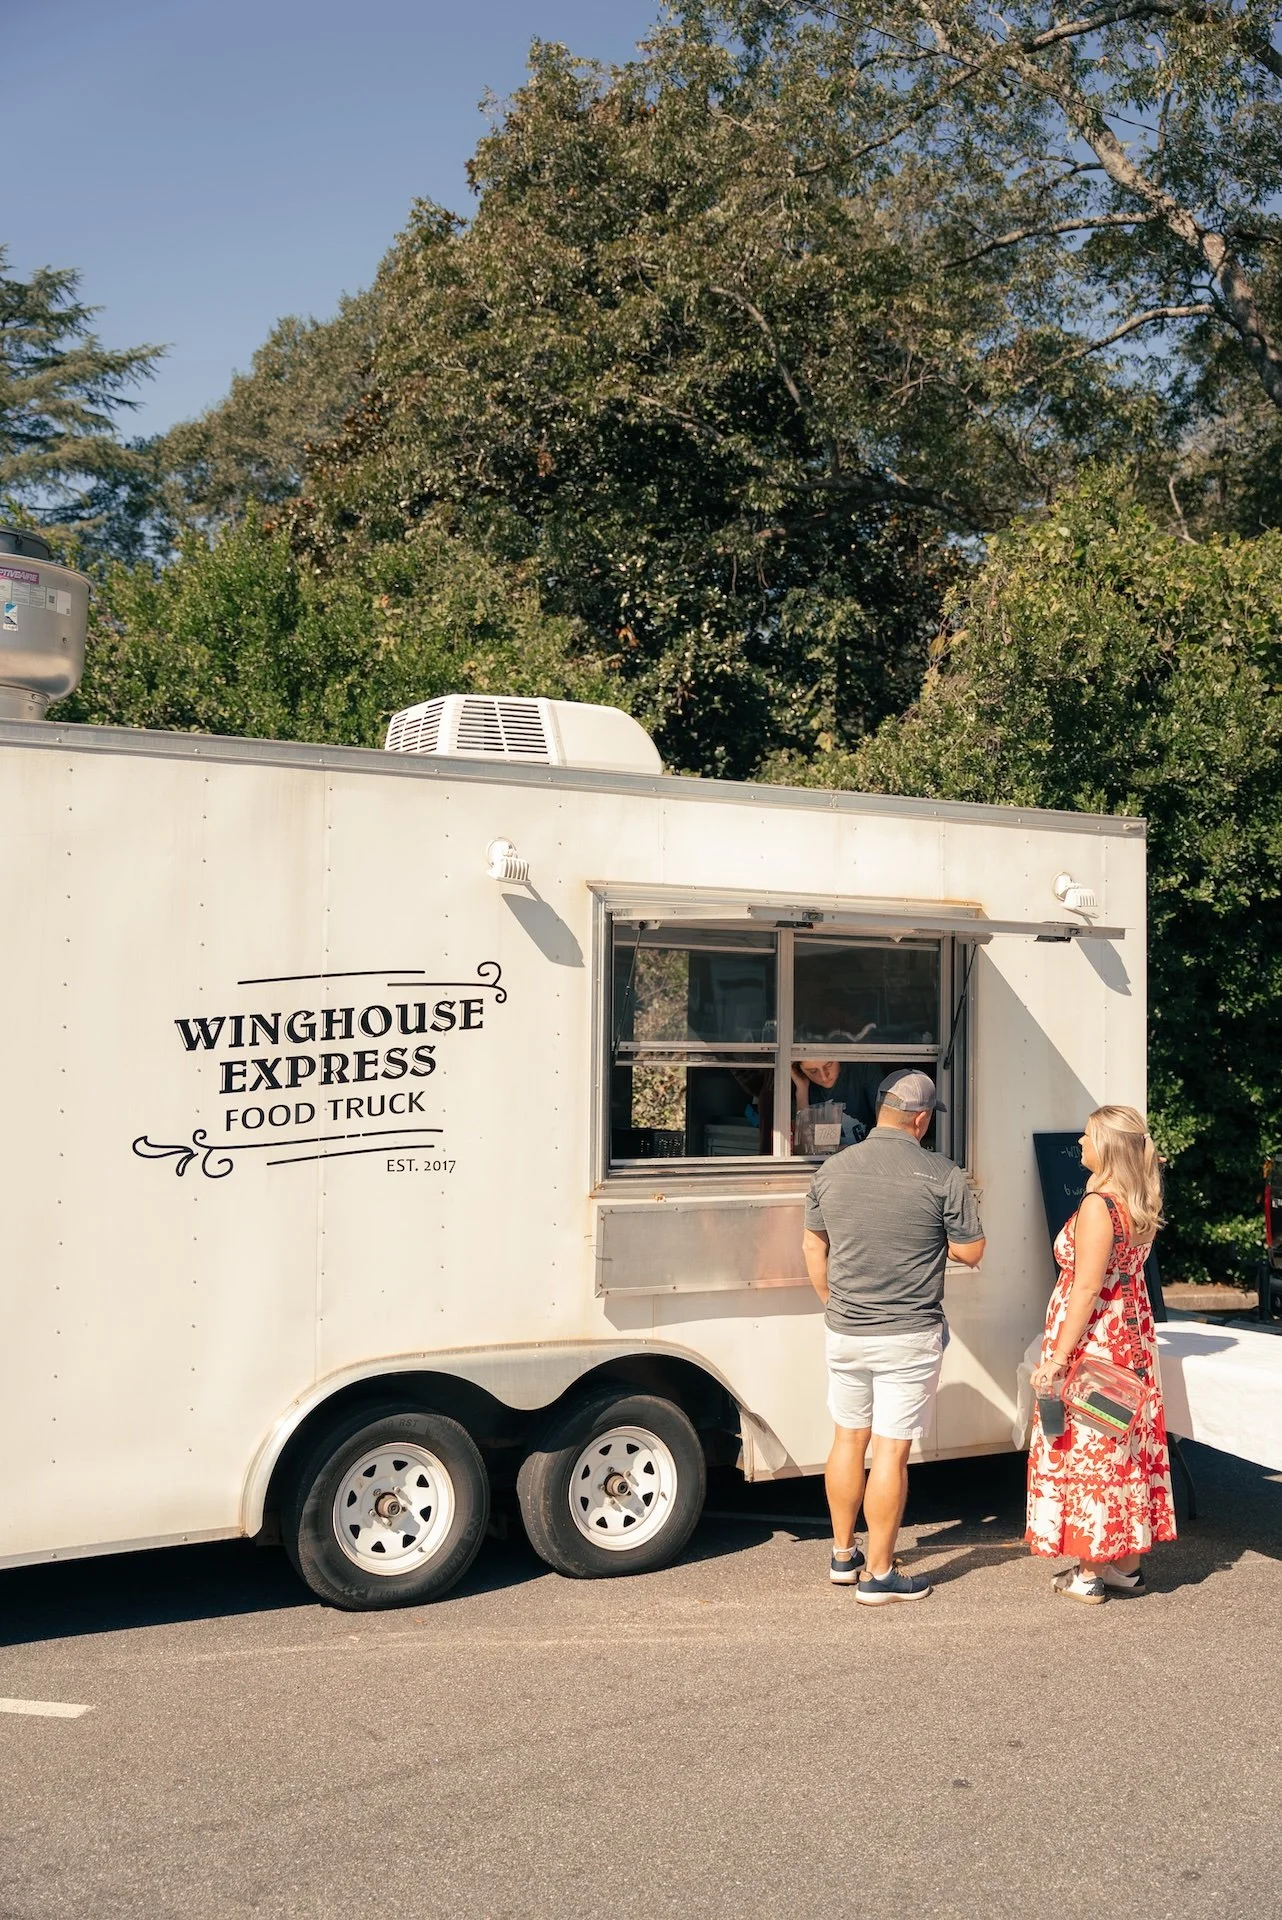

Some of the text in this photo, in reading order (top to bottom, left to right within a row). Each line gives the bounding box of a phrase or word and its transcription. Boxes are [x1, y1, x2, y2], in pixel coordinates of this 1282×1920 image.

[174, 998, 484, 1051] WINGHOUSE
[219, 1044, 437, 1094] EXPRESS
[225, 1091, 426, 1131] FOOD TRUCK
[818, 1127, 838, 1141] TIPS
[387, 1158, 456, 1174] EST. 2017
[1109, 1207, 1123, 1237] HOW
[1121, 1284, 1136, 1319] THEM
[1127, 1324, 1145, 1369] DAWGS
